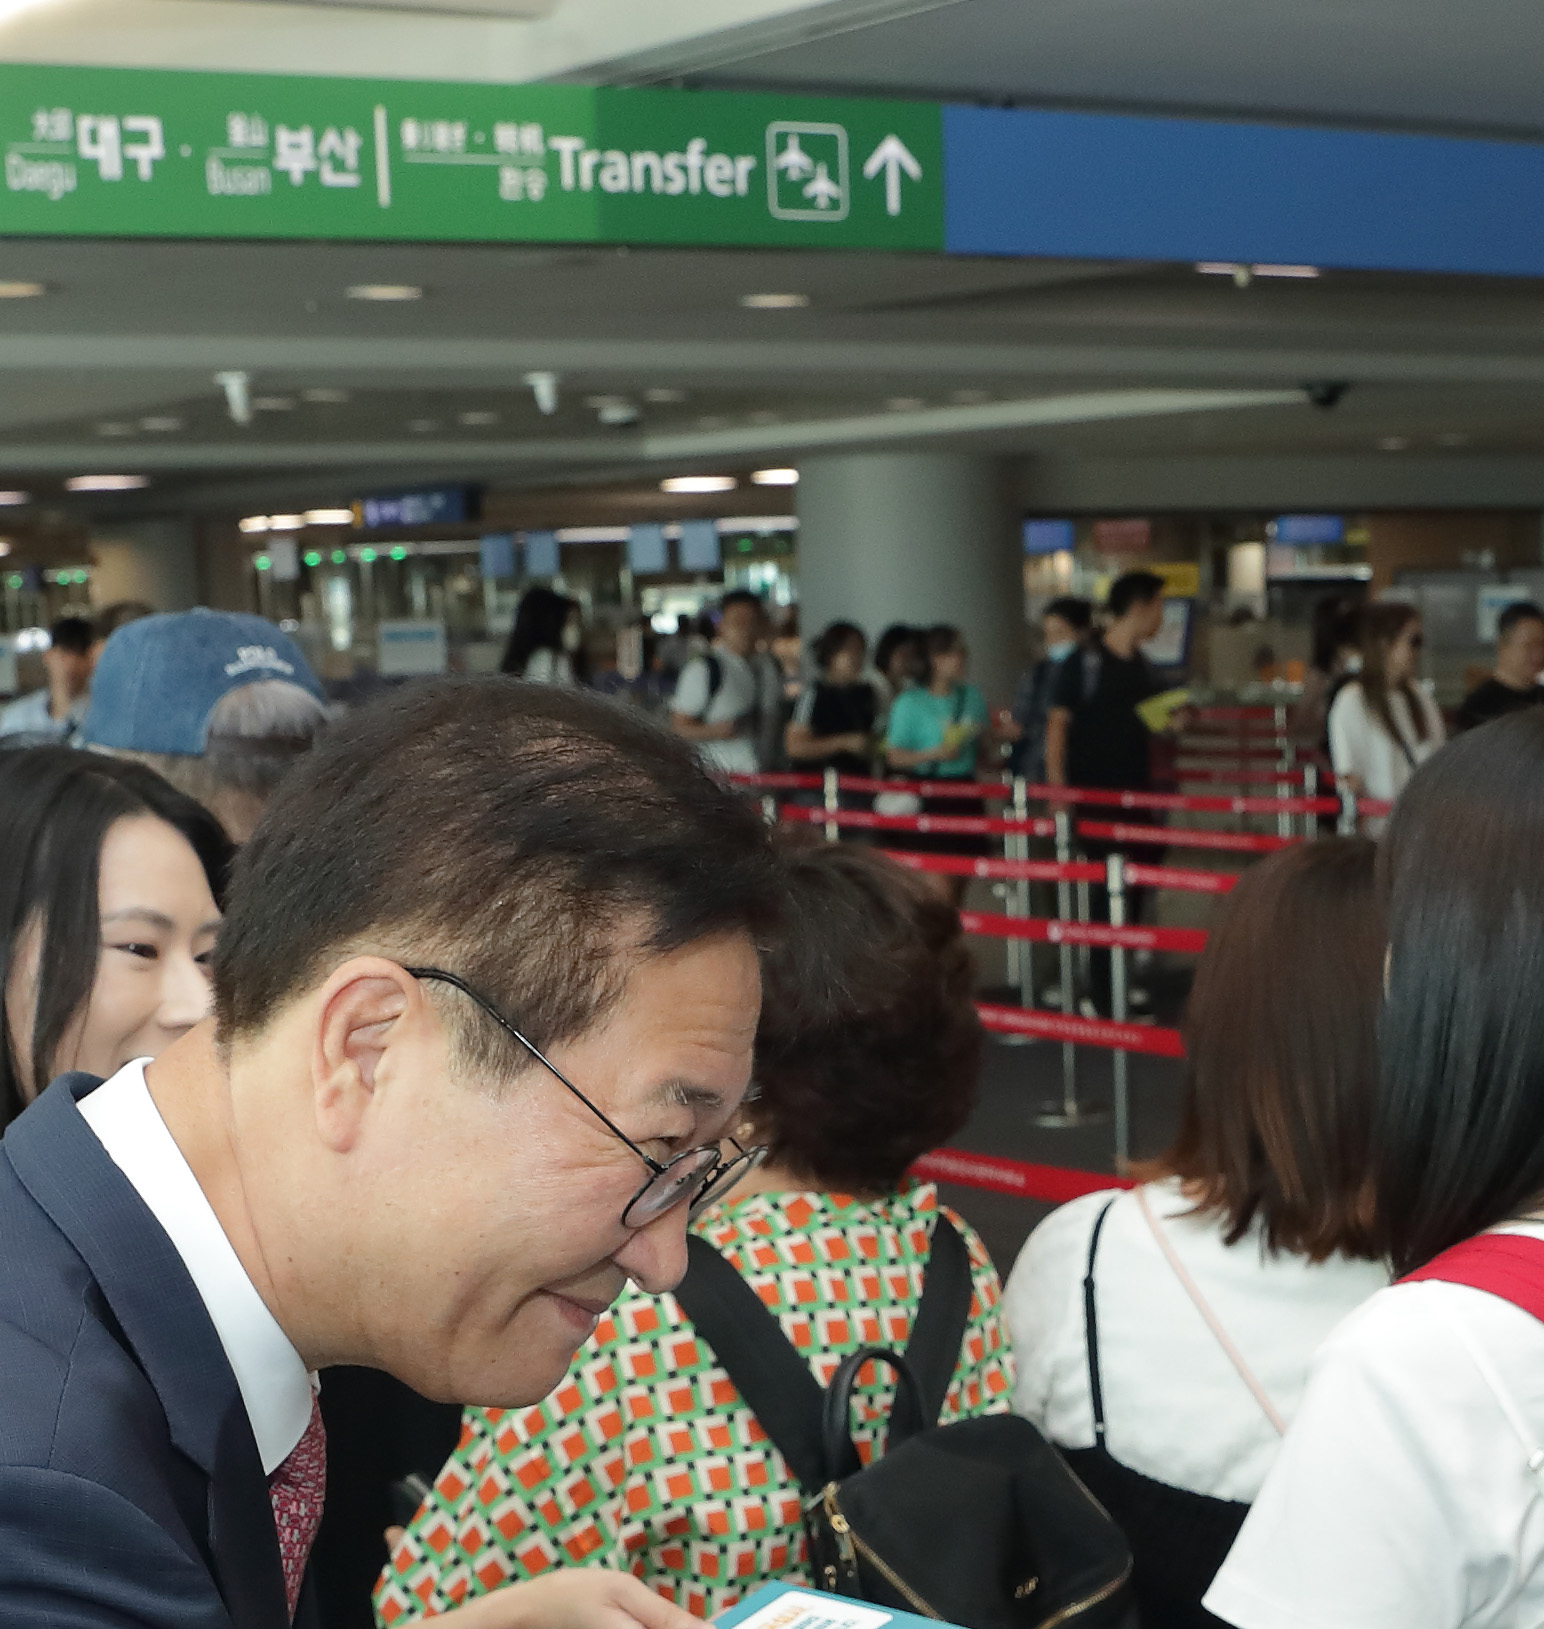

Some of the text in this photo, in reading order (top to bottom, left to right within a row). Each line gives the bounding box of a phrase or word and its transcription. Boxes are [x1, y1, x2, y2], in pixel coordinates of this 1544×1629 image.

[78, 114, 165, 181] 대구
[273, 124, 362, 188] 부산
[548, 135, 756, 196] Transfer
